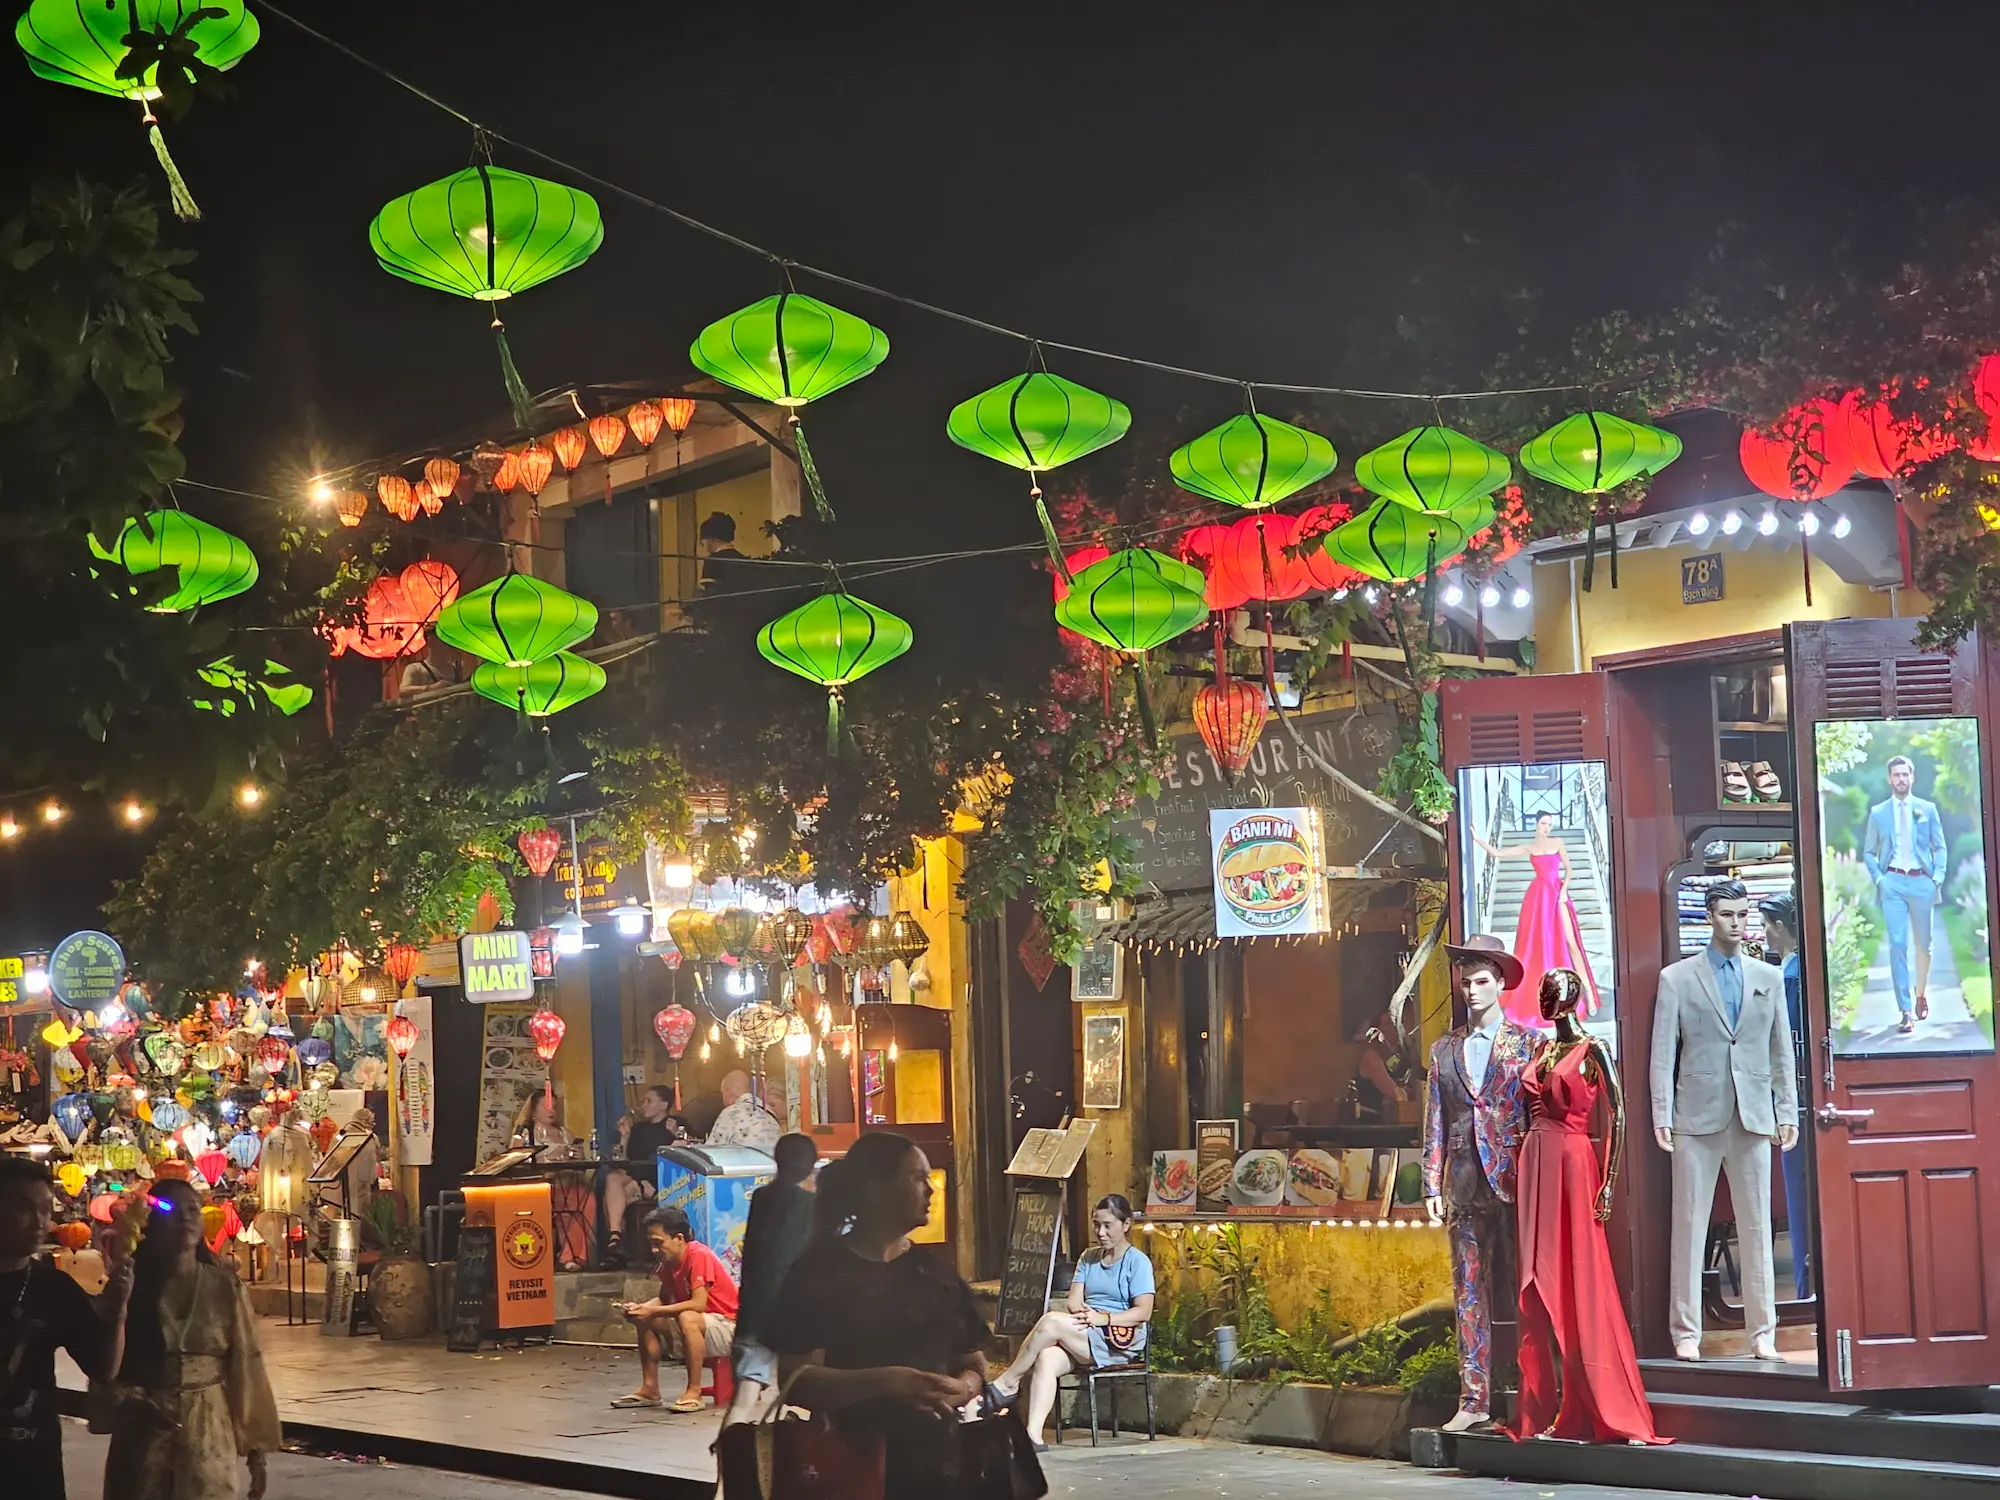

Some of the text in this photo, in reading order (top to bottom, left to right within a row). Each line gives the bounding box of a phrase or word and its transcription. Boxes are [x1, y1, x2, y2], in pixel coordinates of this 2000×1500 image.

[1230, 819, 1272, 842] BÁNH
[564, 886, 584, 900] GOD
[55, 940, 84, 970] Shop
[473, 934, 519, 960] MINI
[467, 963, 529, 993] MART
[68, 989, 111, 999] LANTERN
[1027, 1213, 1054, 1235] HOUR
[508, 1277, 545, 1290] REVISIT
[506, 1289, 548, 1302] VIETNAM
